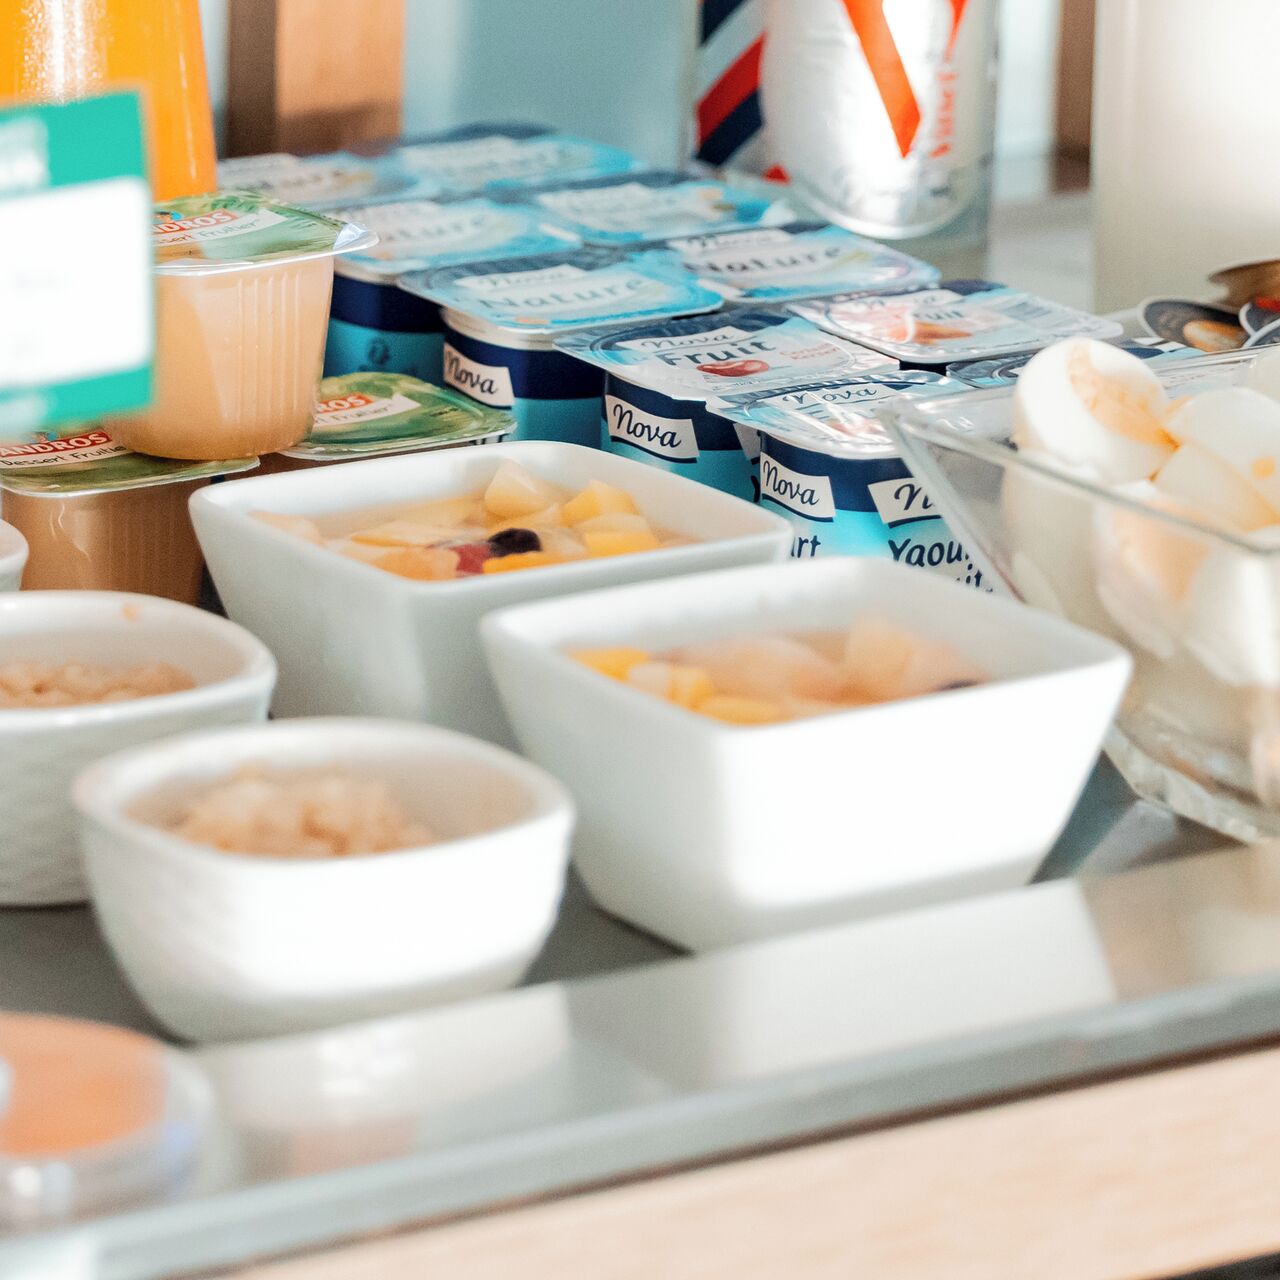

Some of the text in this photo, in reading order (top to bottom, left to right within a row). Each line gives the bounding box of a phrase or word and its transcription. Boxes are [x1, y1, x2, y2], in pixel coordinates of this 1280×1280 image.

[641, 332, 734, 350] Nova
[656, 339, 777, 367] Fruit
[446, 349, 498, 397] Nova
[612, 402, 682, 450] Nova
[0, 431, 108, 458] ANDROS
[0, 445, 128, 467] Dessert Fruitie
[761, 459, 820, 506] Nova
